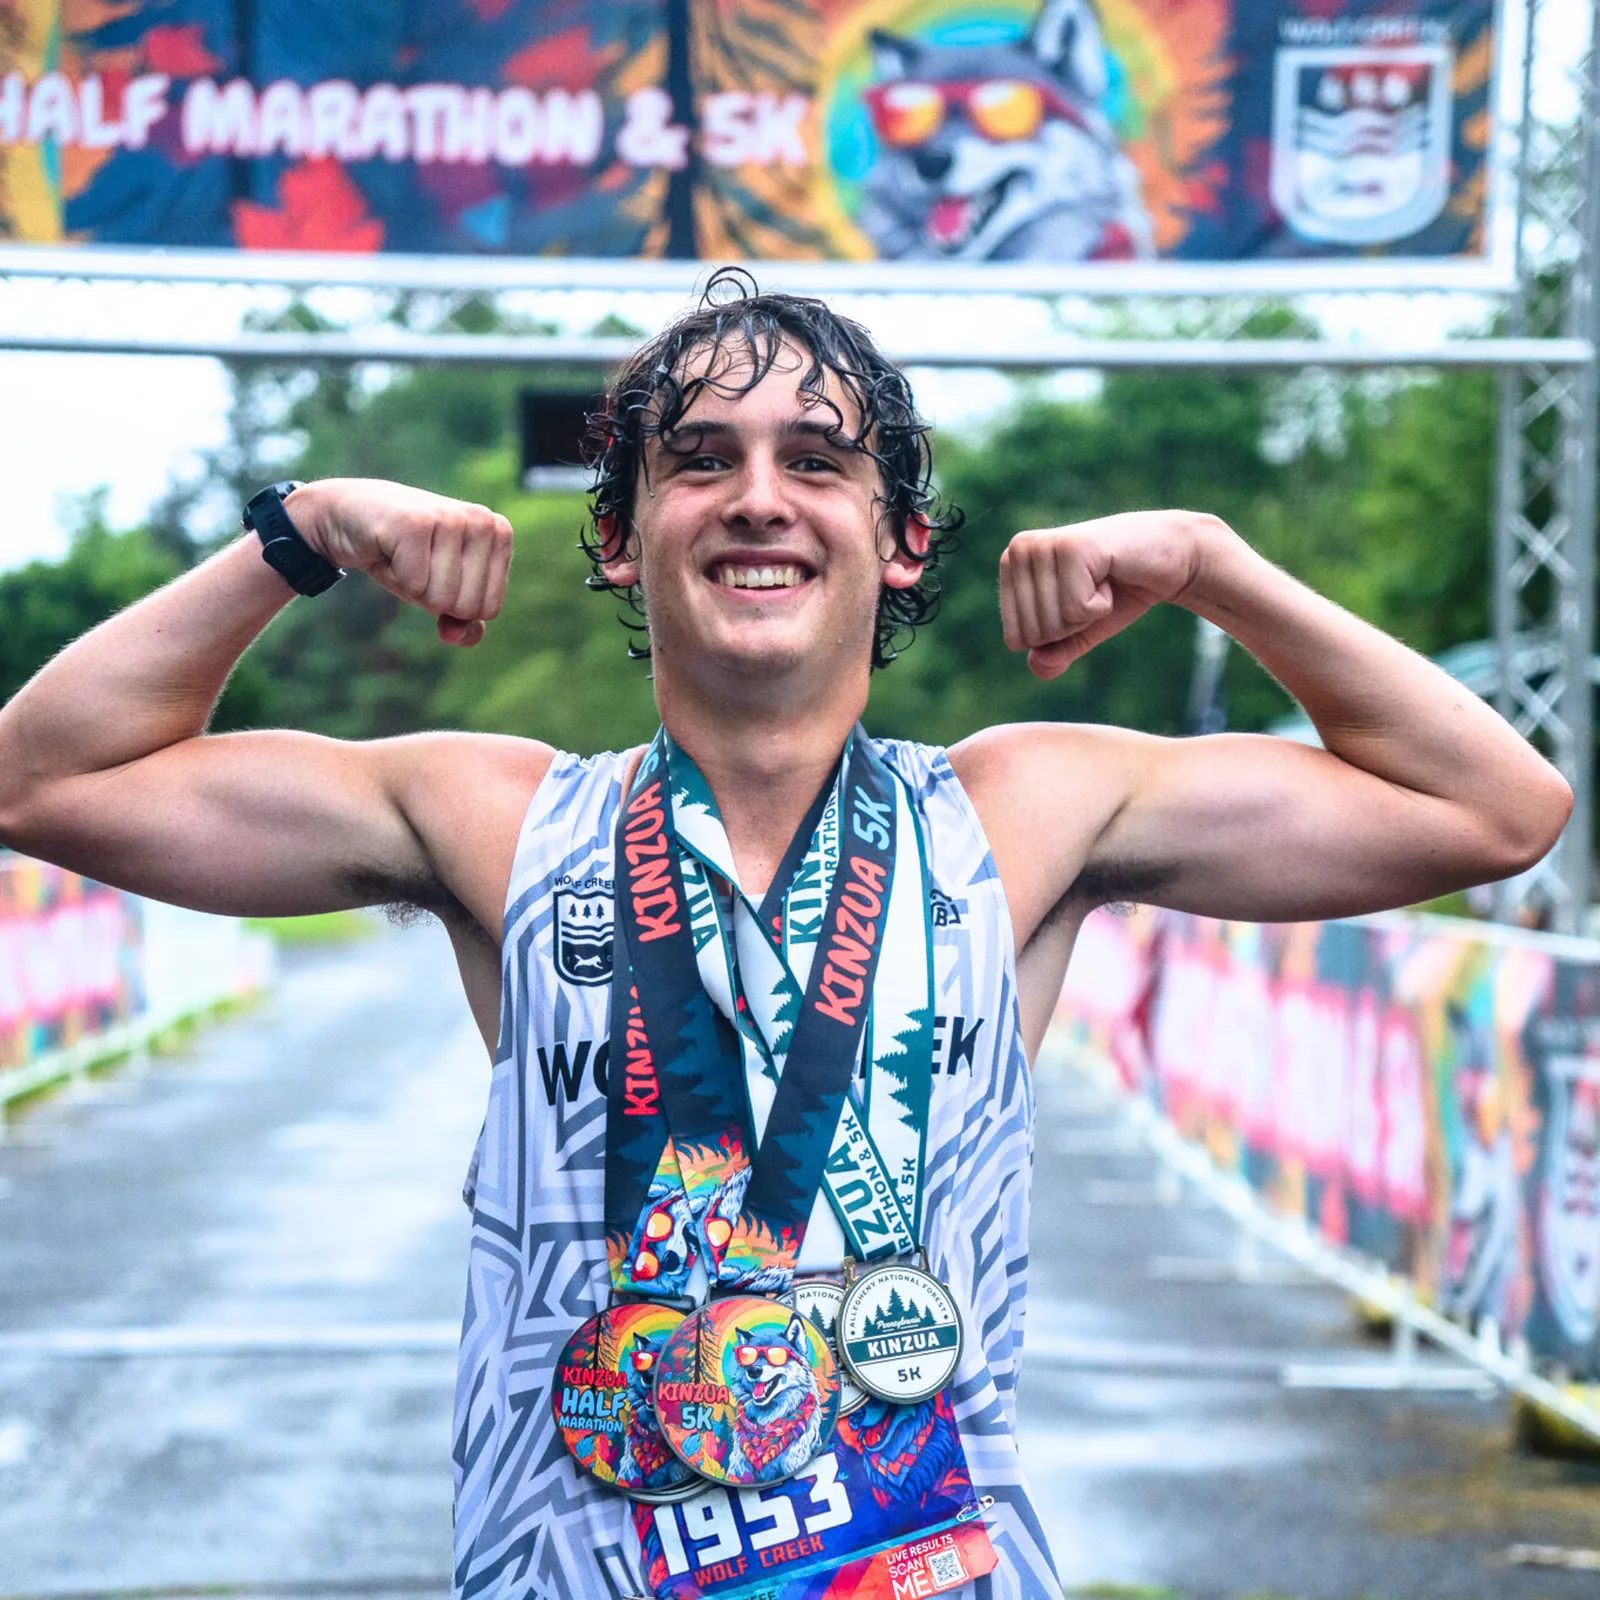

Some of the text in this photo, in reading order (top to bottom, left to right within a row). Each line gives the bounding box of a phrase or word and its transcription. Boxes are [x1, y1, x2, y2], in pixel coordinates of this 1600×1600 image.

[0, 70, 809, 171] HALF MARATHON & 5K
[624, 781, 681, 942] KINZUA
[680, 853, 719, 955] ZUA
[814, 785, 892, 1027] KINZUA 5K
[841, 1114, 864, 1145] 5K
[859, 1148, 872, 1161] &
[901, 1158, 916, 1186] 5K
[799, 1291, 841, 1304] NATIONA
[850, 1274, 947, 1328] ALLEGHENY NATIONAL FOREST
[876, 1315, 921, 1330] Pennsylvania
[867, 1331, 941, 1358] KINZUA
[563, 1366, 628, 1389] KINZUA
[897, 1366, 922, 1382] 5K
[561, 1387, 627, 1418] HALF
[657, 1382, 730, 1404] KINZUA
[558, 1415, 623, 1433] MARATHON
[681, 1406, 713, 1431] 5K
[653, 1452, 853, 1576] 1953
[694, 1534, 825, 1587] WOLF CREEK
[886, 1533, 954, 1566] LIVE RESULTS
[888, 1557, 923, 1579] SCAN
[891, 1569, 932, 1600] ME
